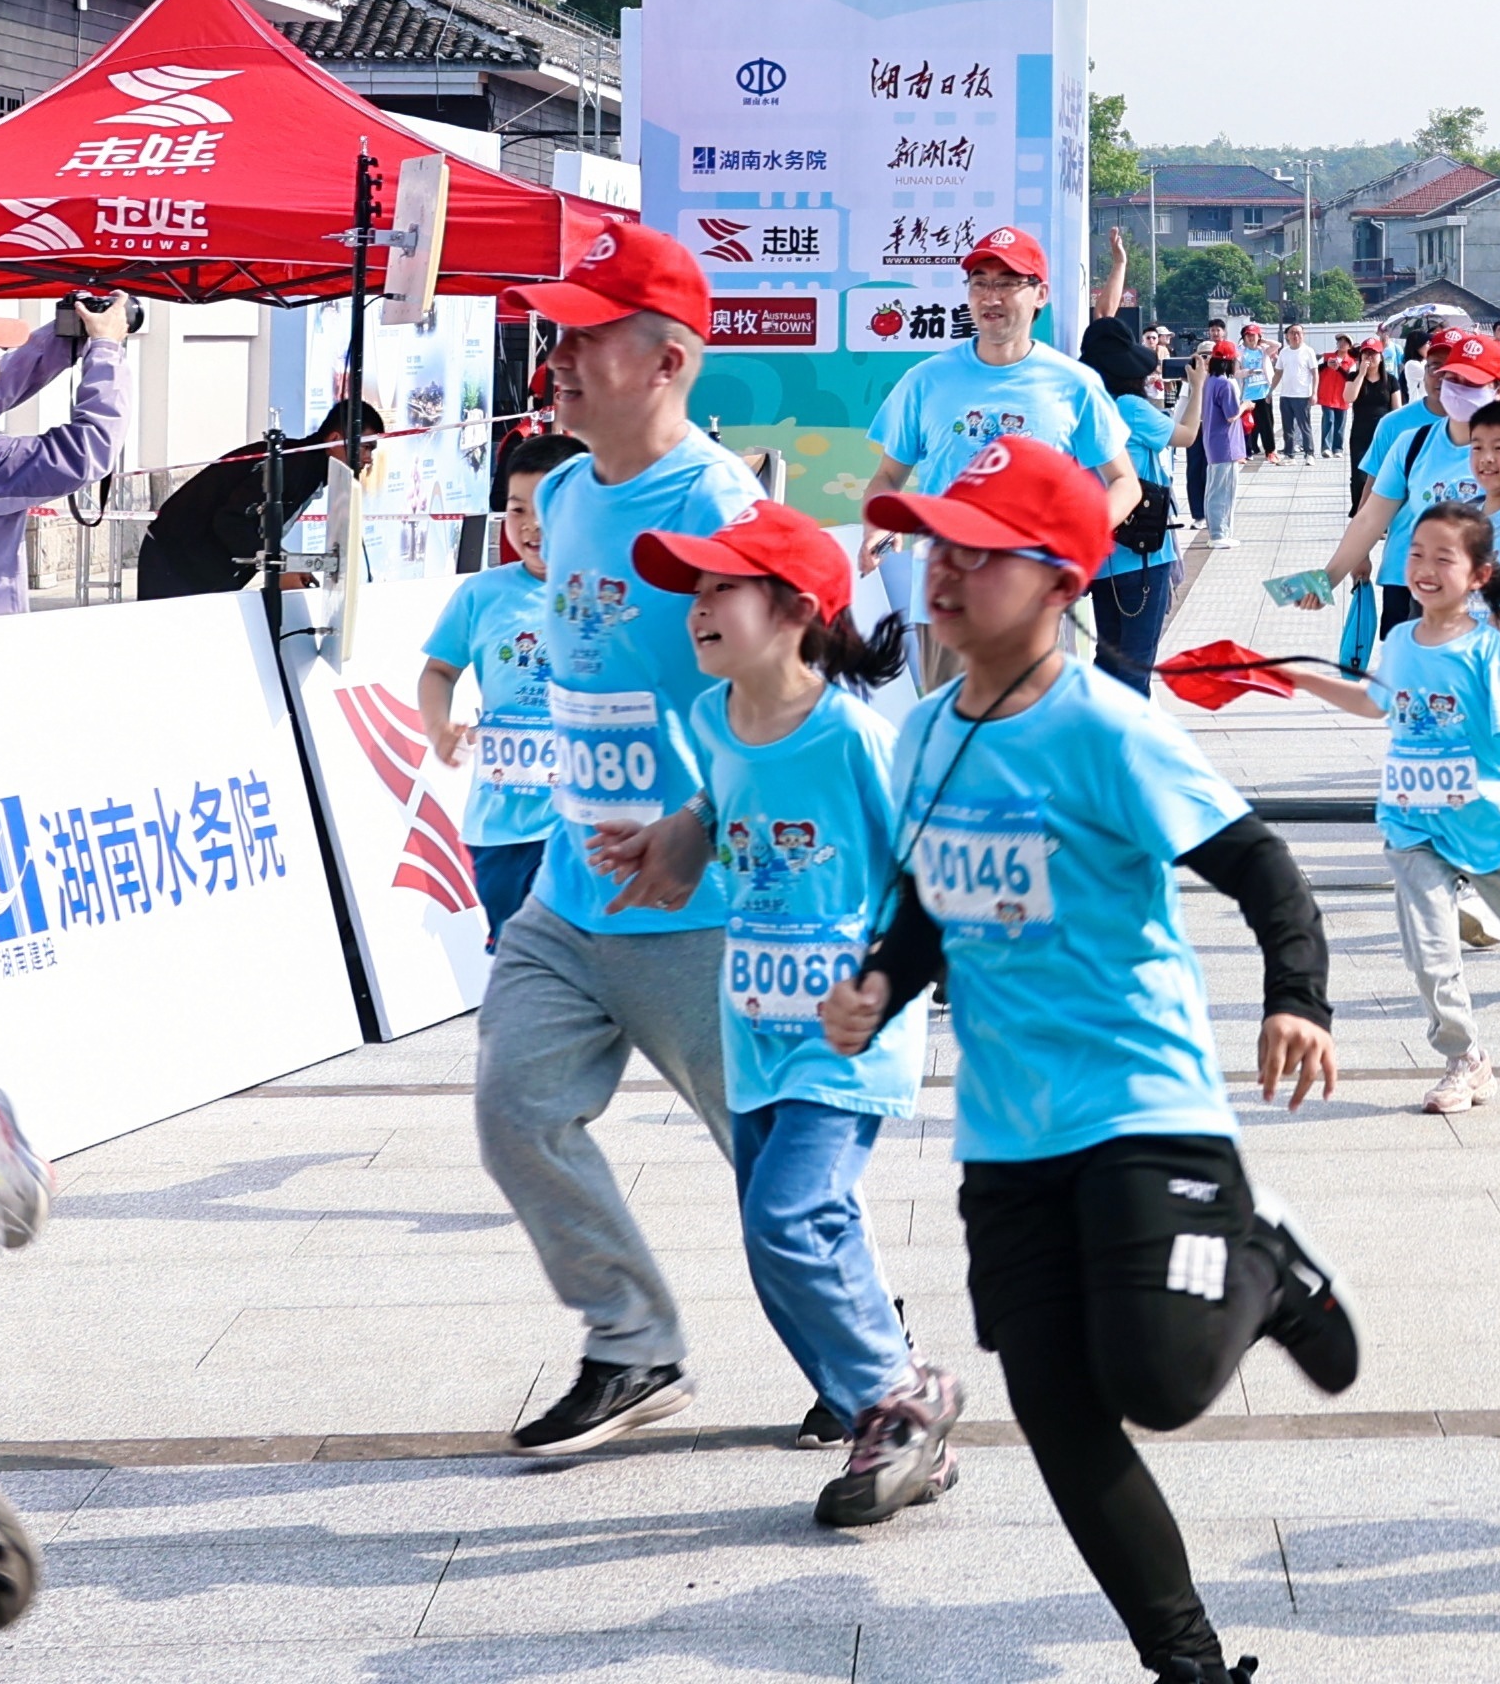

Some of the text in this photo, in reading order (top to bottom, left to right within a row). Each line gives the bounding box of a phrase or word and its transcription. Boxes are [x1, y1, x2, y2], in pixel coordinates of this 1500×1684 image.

[62, 130, 229, 170] 走娃
[719, 148, 827, 172] 湖南水务院
[887, 136, 975, 172] 新湖南
[895, 176, 965, 186] HUNAN DAILY
[94, 197, 210, 237] 走娃
[110, 237, 191, 251] zouwa
[761, 226, 820, 255] 走娃
[885, 256, 962, 265] www.voc.com.
[711, 308, 758, 336] 澳牧
[910, 304, 978, 340] 茄皇
[482, 735, 557, 769] B006
[557, 736, 656, 791] 0080
[1386, 764, 1473, 792] B0002
[39, 768, 286, 933] 湖南水务院
